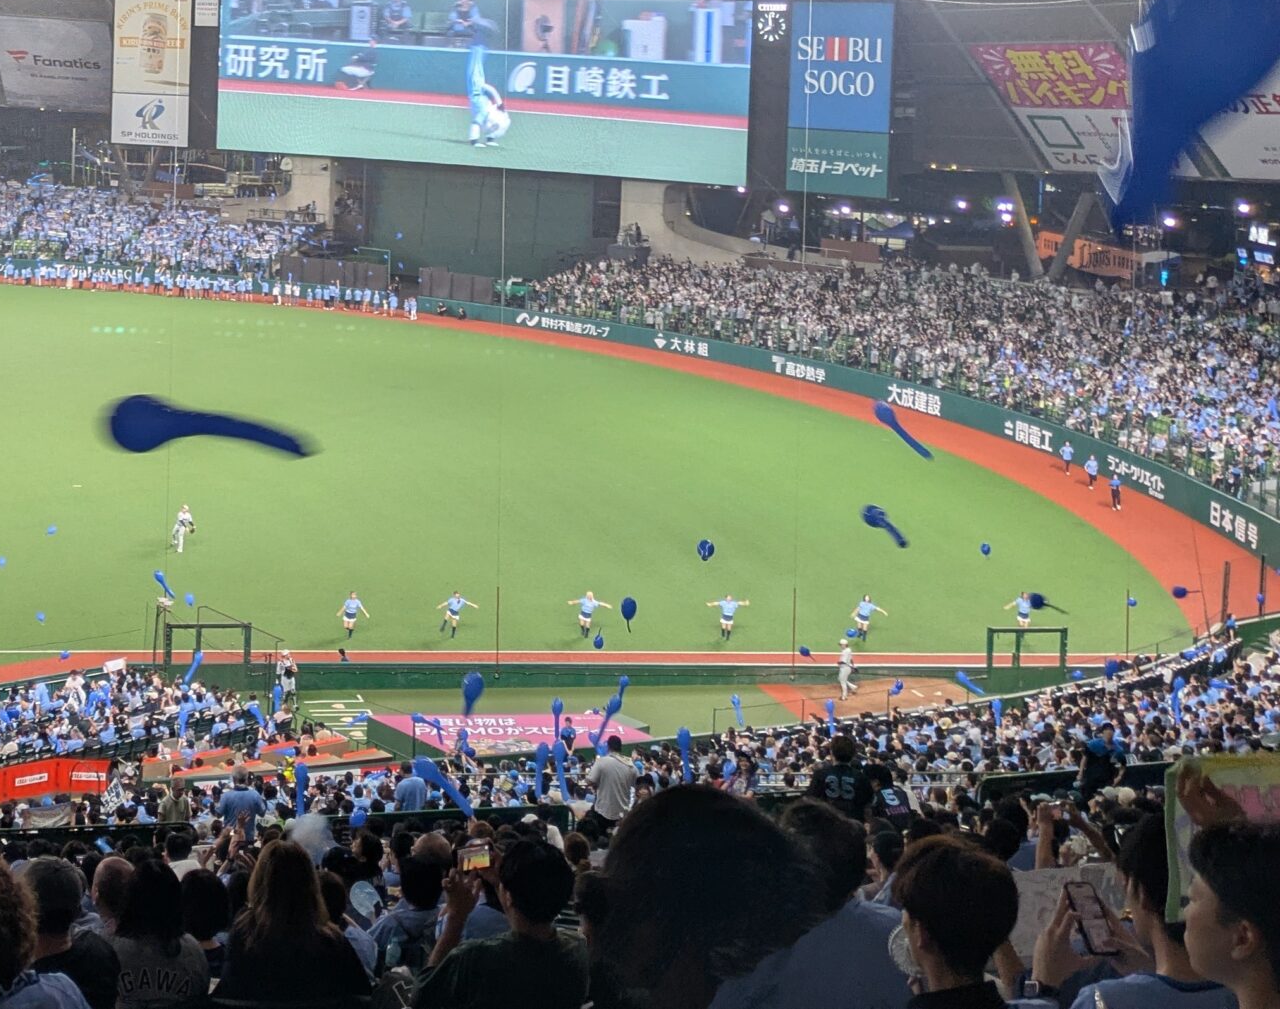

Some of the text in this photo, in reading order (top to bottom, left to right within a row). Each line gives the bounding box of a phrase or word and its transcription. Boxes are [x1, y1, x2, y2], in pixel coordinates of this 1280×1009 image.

[32, 54, 102, 70] Fanatics
[797, 36, 883, 64] SEIBU
[1005, 48, 1096, 81] 無料
[545, 65, 670, 100] 目崎鉄工
[803, 69, 875, 97] SOGO
[789, 157, 884, 179] 埼玉トヨペット
[540, 315, 611, 338] 野村不動産グループ
[670, 336, 709, 358] 大林組
[785, 361, 826, 383] 高砂熱学
[887, 383, 942, 418] 大成建設
[1015, 419, 1053, 453] 関電工
[1106, 454, 1165, 492] ランドクリエイト
[1209, 500, 1259, 550] 日本信号
[824, 774, 856, 801] 35
